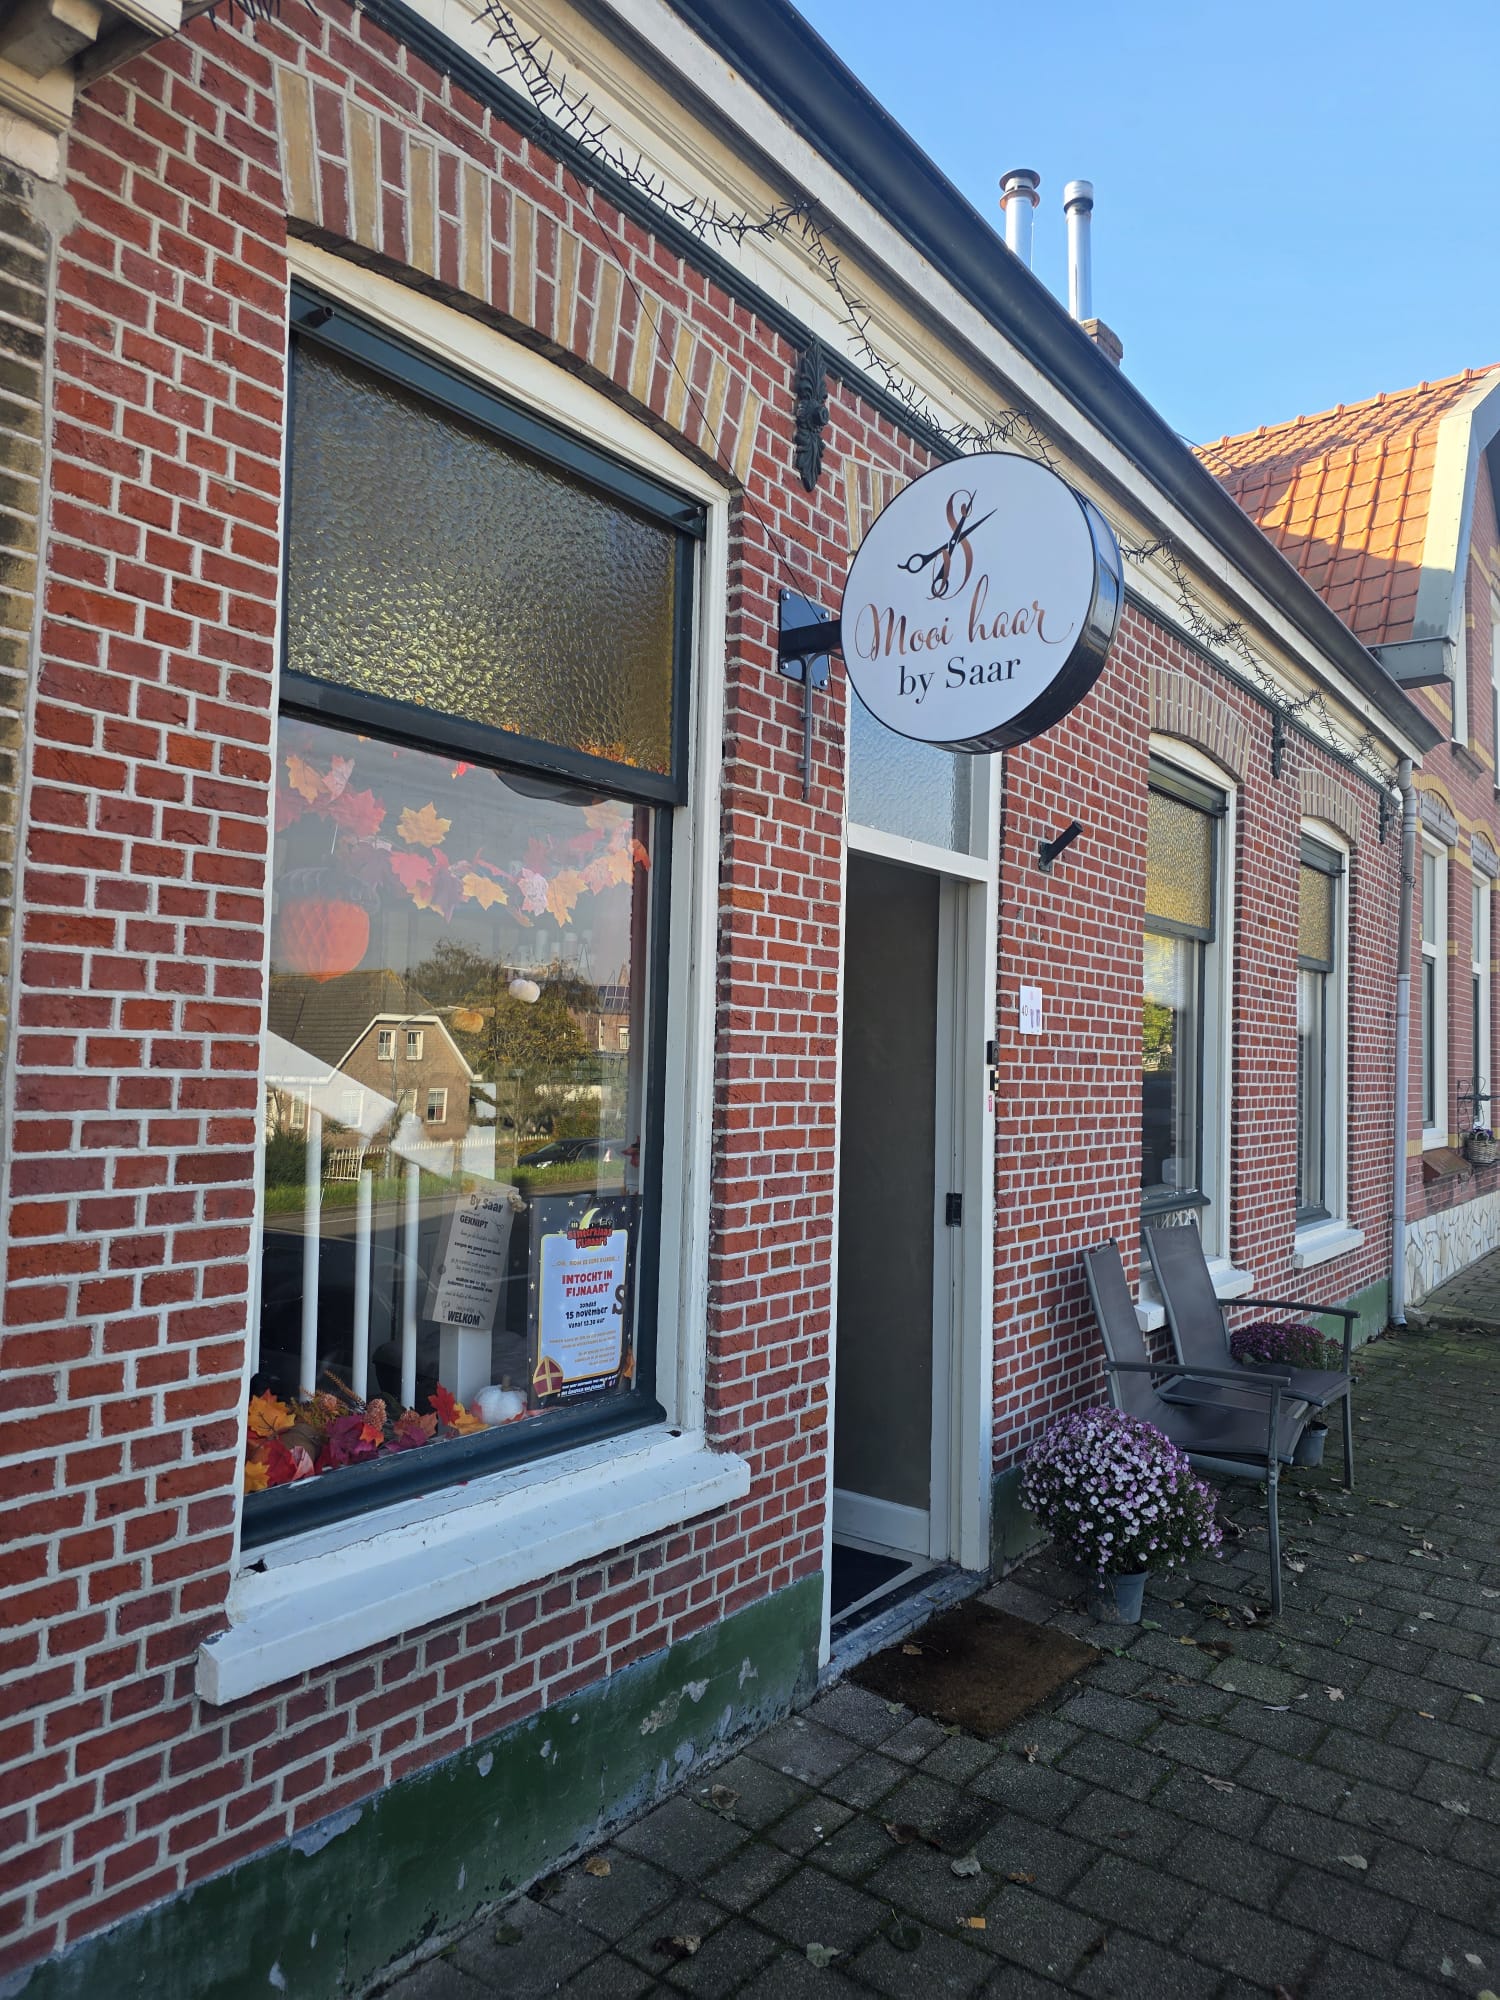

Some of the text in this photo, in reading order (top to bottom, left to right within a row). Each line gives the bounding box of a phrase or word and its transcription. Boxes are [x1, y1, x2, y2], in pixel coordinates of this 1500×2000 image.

[854, 573, 1075, 662] Mooi haar
[897, 656, 1021, 704] by Saar
[470, 1194, 481, 1211] By
[482, 1198, 503, 1213] Saar
[459, 1214, 489, 1229] GEKNIPT
[562, 1270, 613, 1285] INTOCHT IN
[566, 1283, 610, 1297] FIJNAART
[447, 1310, 481, 1326] WELKOM
[565, 1307, 608, 1320] 15 november
